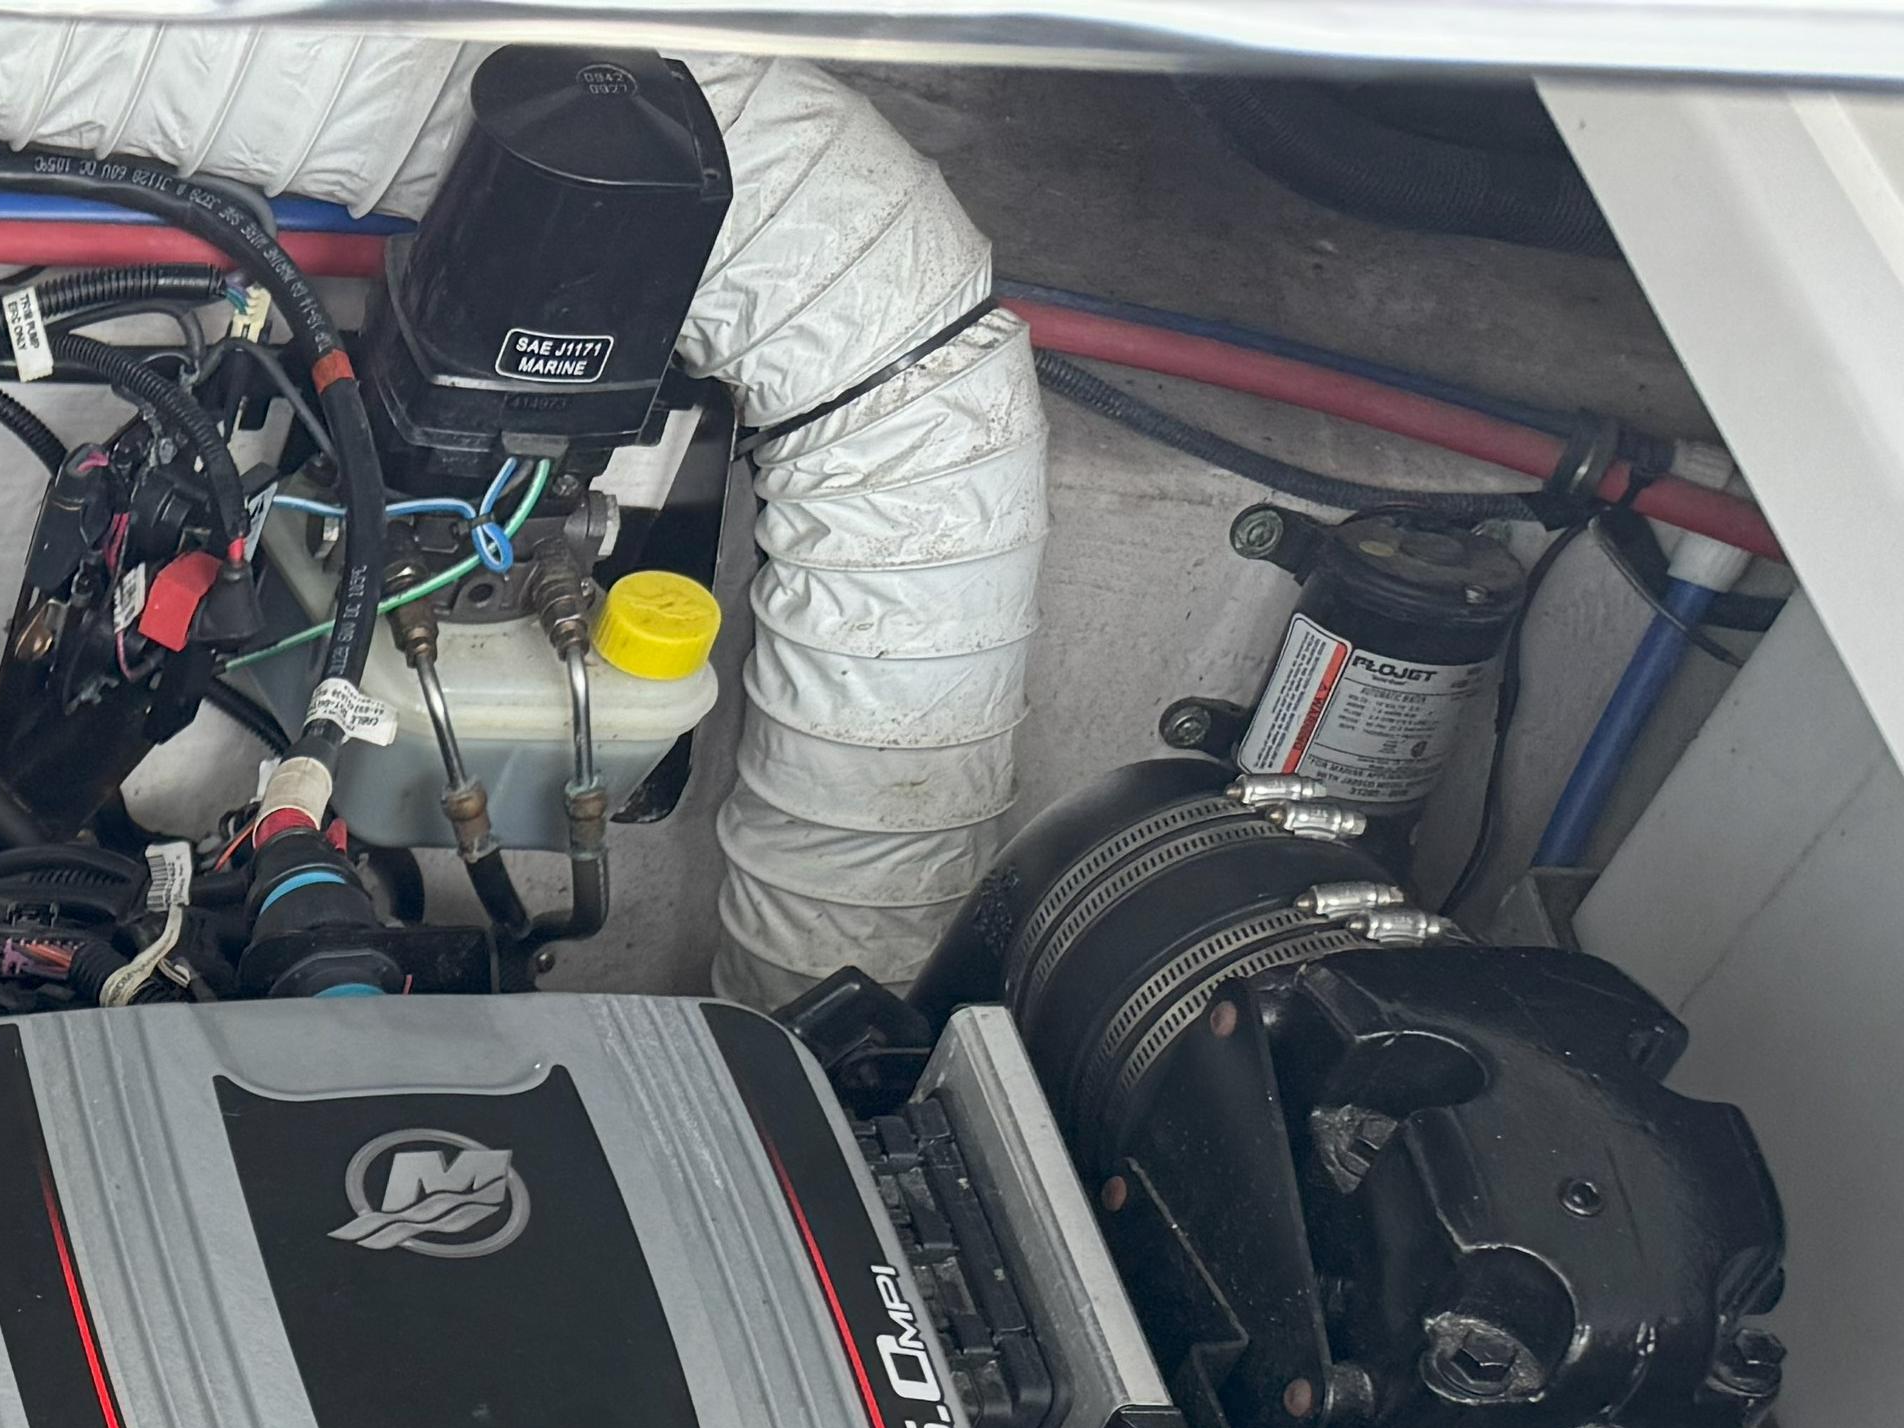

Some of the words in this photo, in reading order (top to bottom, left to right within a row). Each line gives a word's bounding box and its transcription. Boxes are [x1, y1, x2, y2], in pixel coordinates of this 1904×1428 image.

[13, 325, 28, 350] ONLY
[26, 321, 40, 349] PUMP
[515, 337, 554, 356] SAE
[555, 342, 603, 357] J1171
[518, 357, 589, 376] MARINE
[1351, 655, 1438, 682] FLOJET
